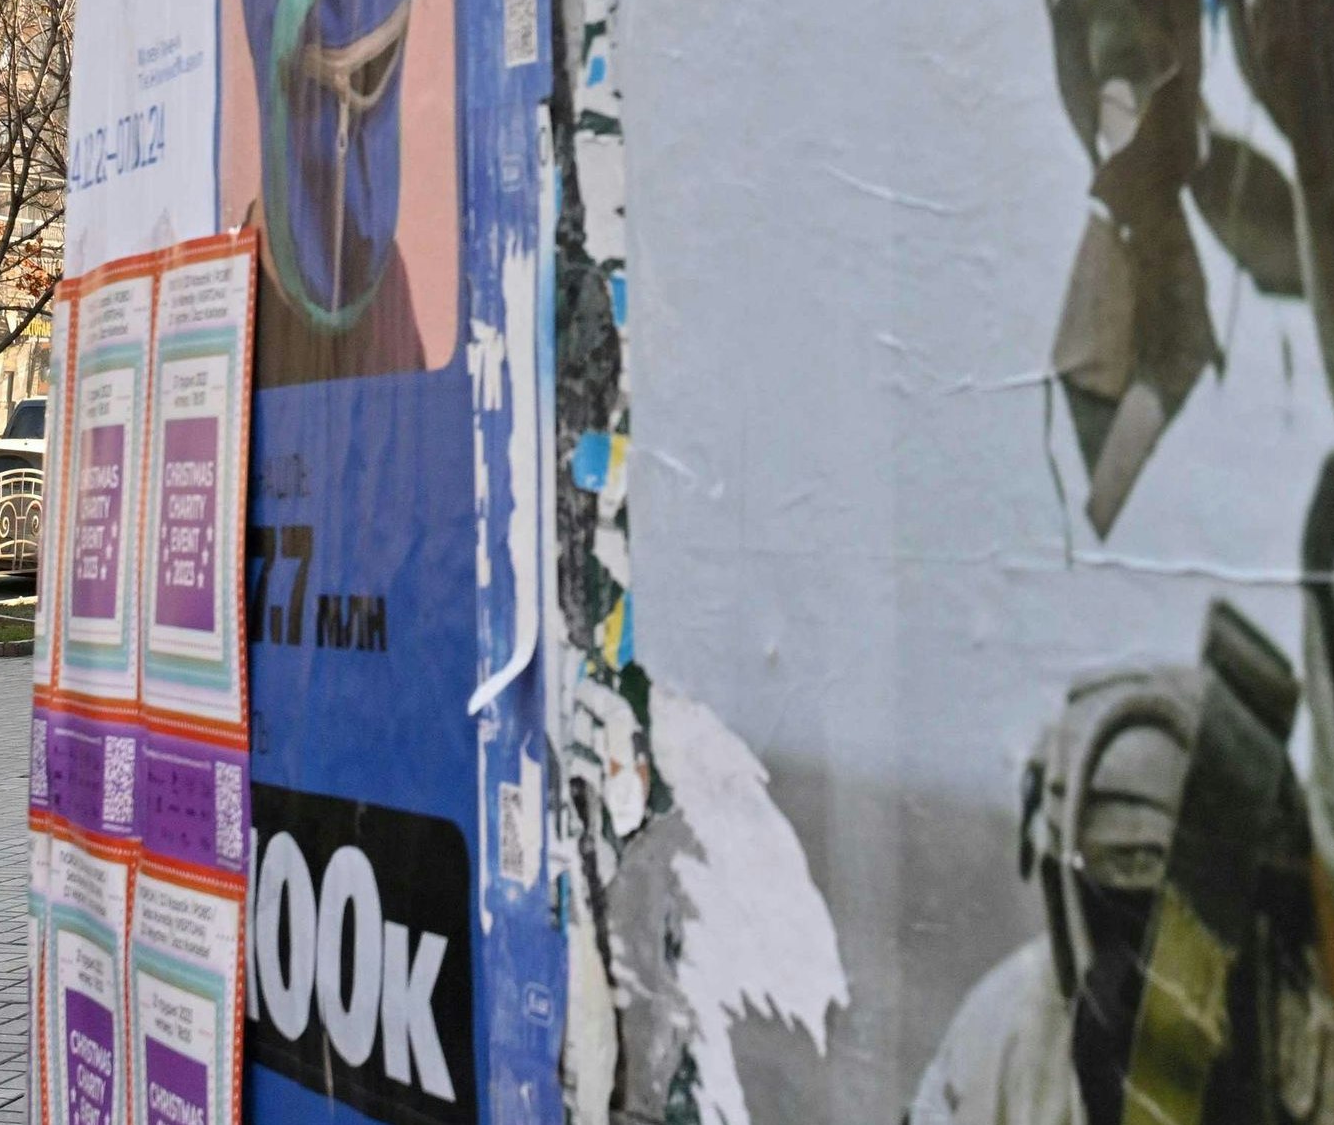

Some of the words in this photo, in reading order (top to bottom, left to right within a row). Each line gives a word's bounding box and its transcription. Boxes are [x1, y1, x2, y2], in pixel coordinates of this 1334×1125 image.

[166, 461, 214, 487] CHRISTMAS
[169, 493, 207, 521] CHARITY
[170, 526, 201, 553] EVENT
[69, 1029, 113, 1078] CHRISTMAS
[77, 1063, 106, 1106] CHARITY
